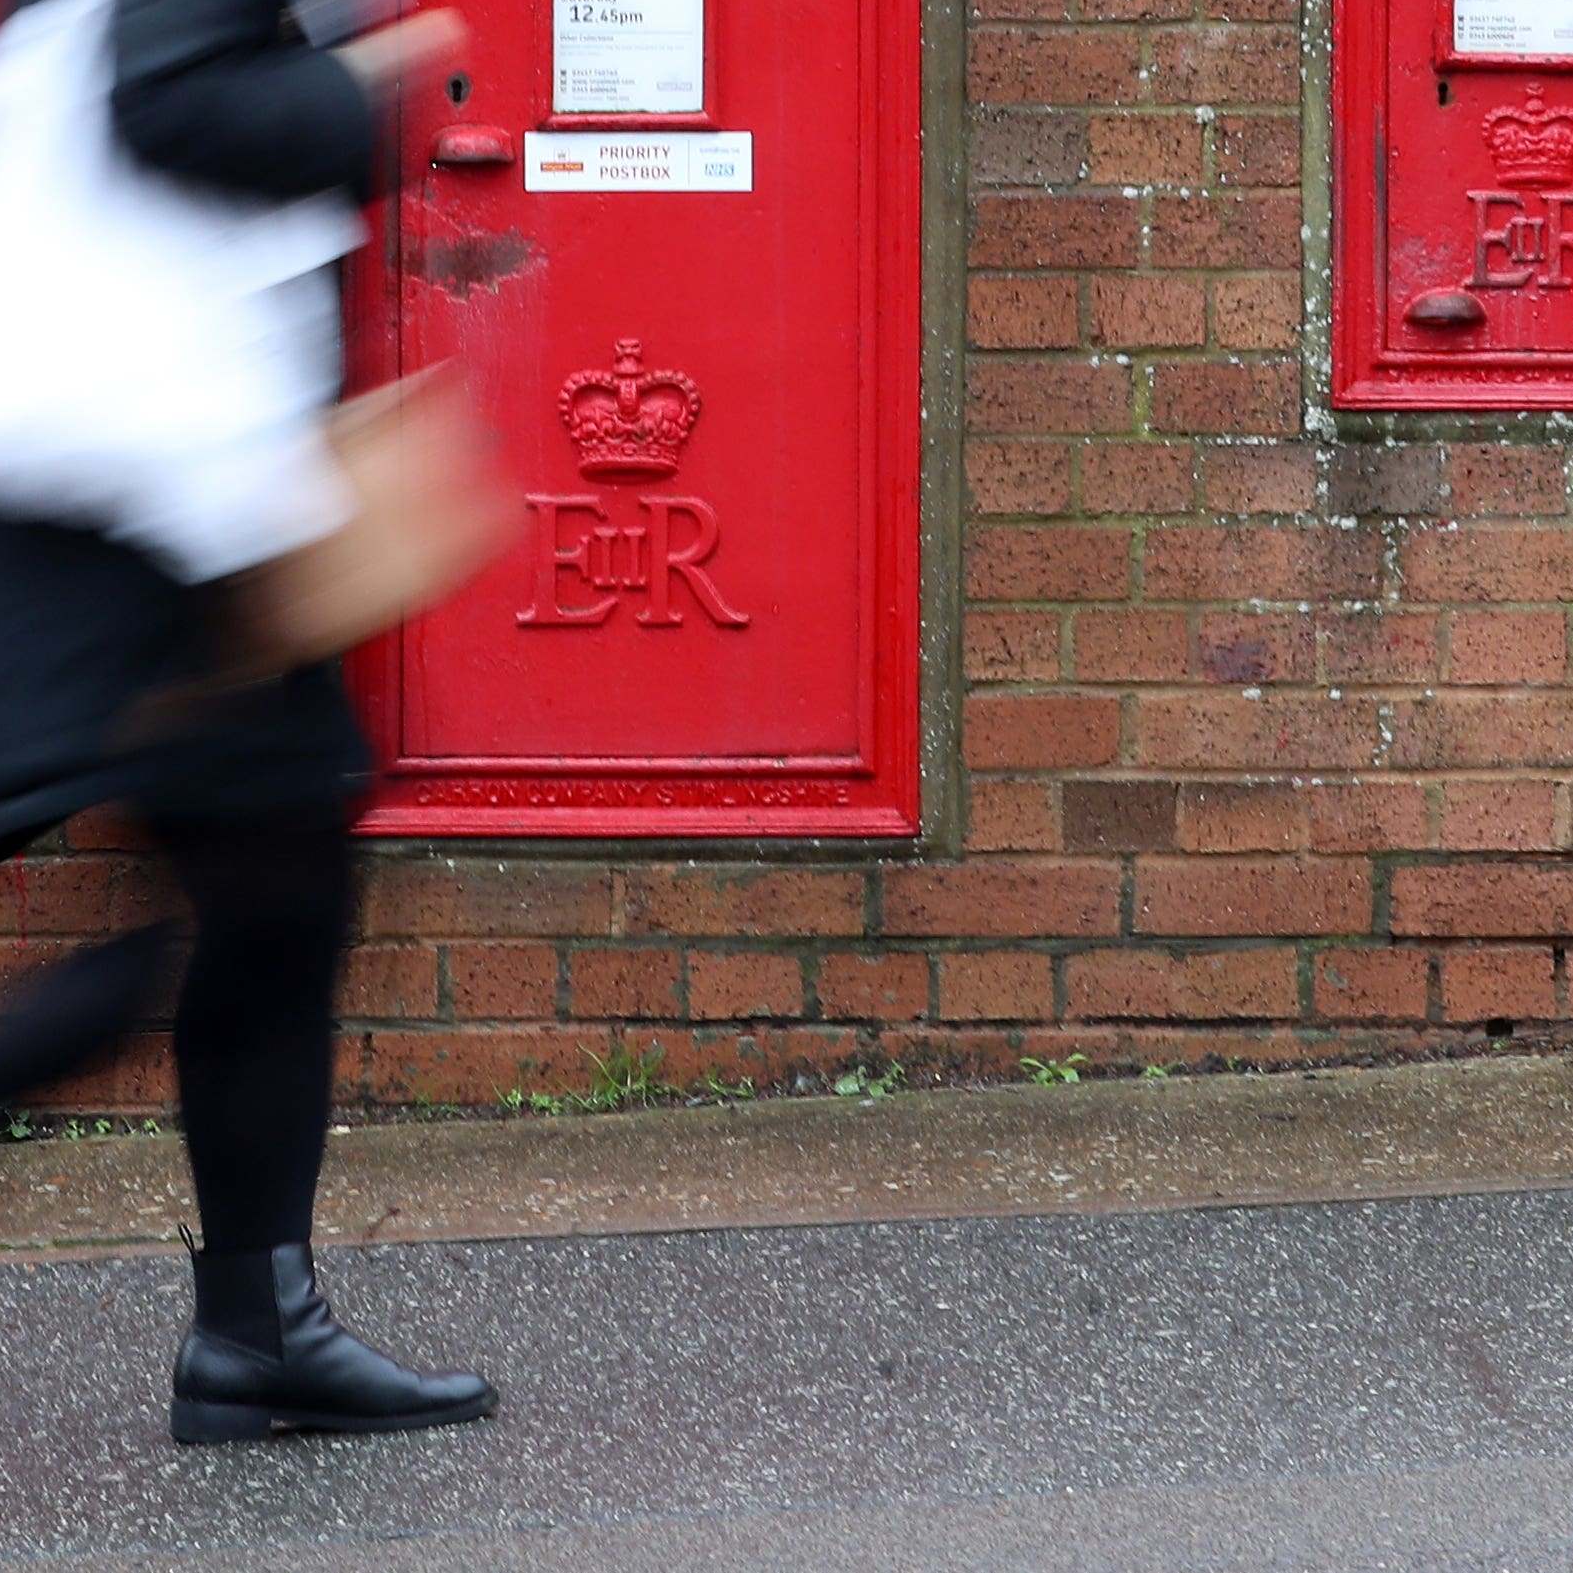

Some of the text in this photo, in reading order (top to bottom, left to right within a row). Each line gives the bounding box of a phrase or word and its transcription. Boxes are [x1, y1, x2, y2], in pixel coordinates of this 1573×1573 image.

[569, 4, 644, 26] 12.45pm
[600, 145, 672, 160] PRIORITY
[600, 165, 672, 180] POSTBOX
